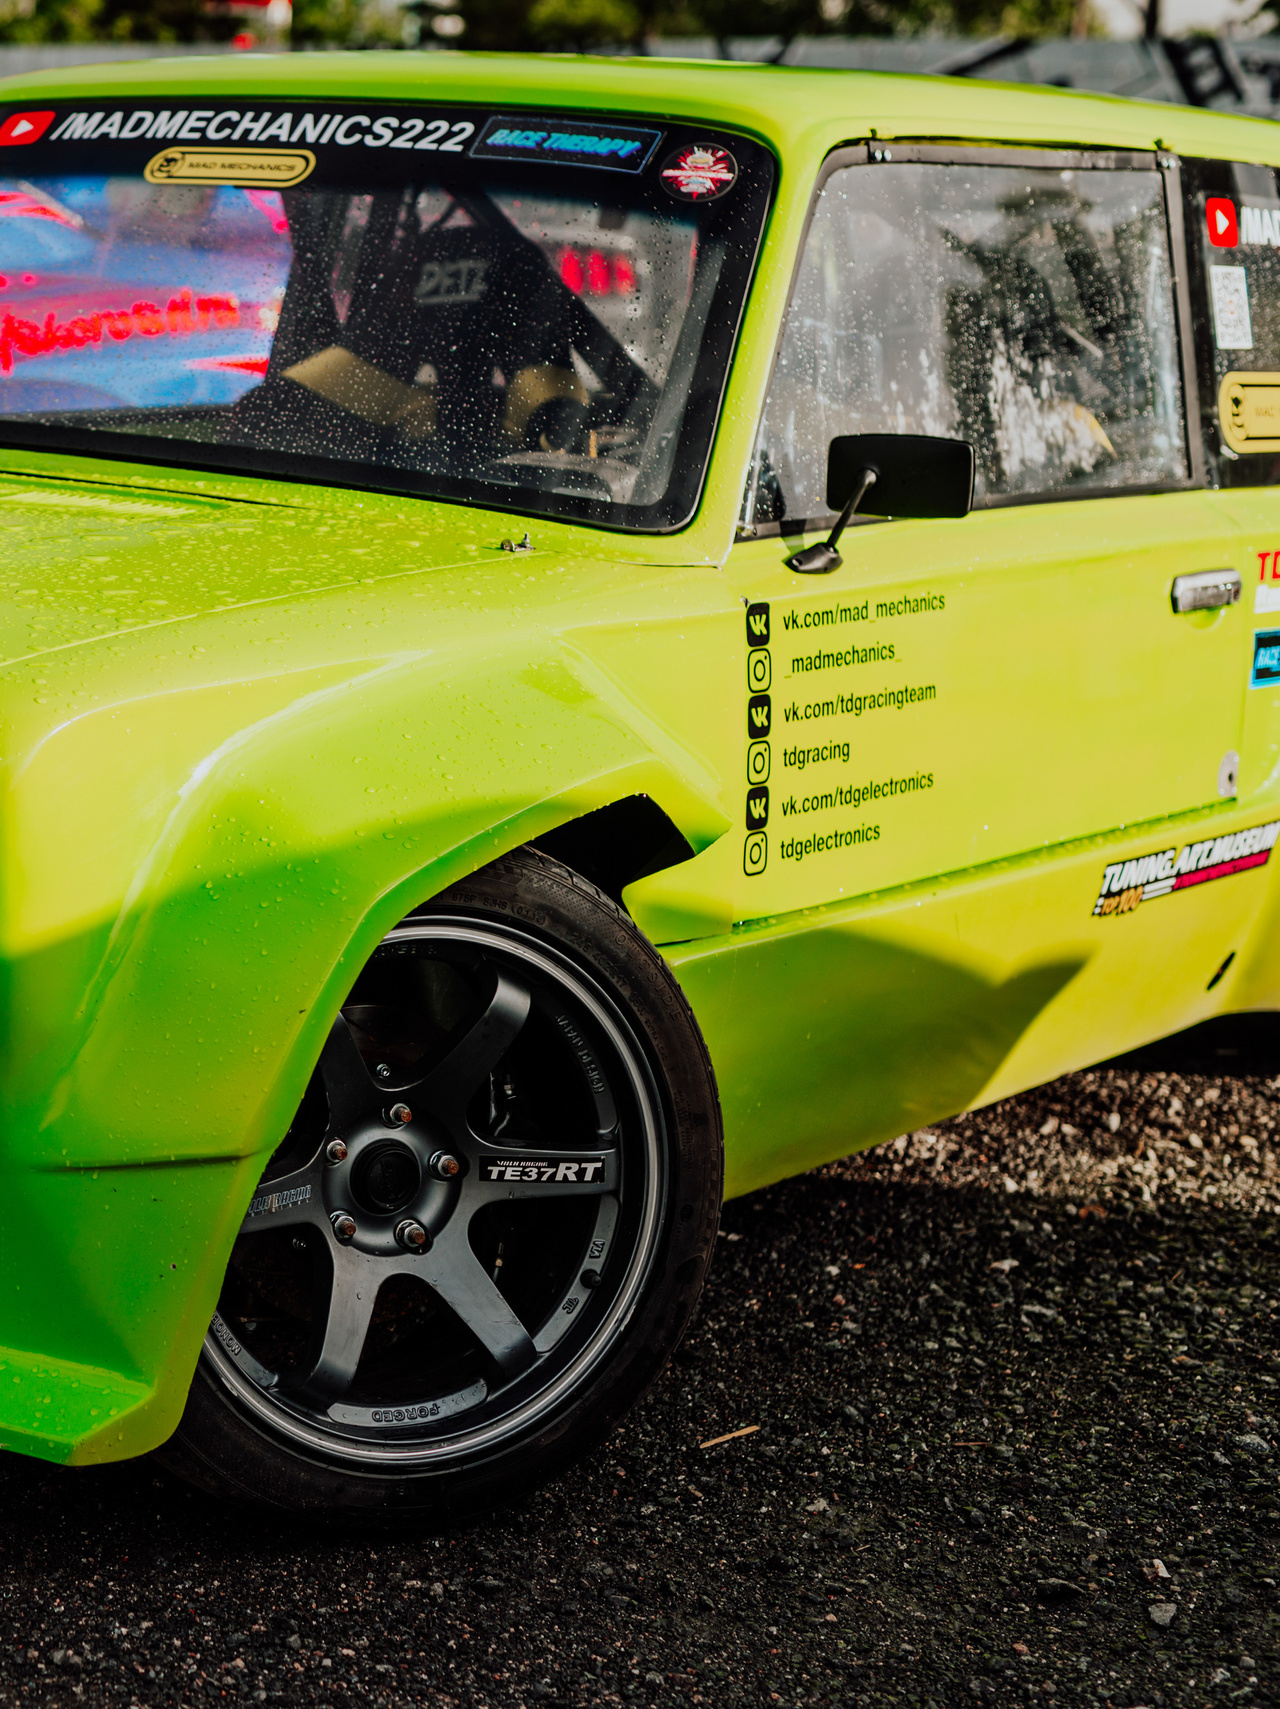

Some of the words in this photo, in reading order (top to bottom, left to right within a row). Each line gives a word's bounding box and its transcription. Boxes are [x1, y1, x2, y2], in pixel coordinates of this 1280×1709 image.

[49, 110, 475, 152] /MADMECHANICS222
[783, 592, 945, 630] vk.com/mad_mechanics
[784, 684, 936, 723] vk.com/tdgracingteam
[783, 740, 850, 770] tdgracing
[782, 771, 934, 816] vk.com/tdgelectronics
[780, 823, 881, 861] tdgelectronics
[615, 934, 682, 1021] OUTSIDE
[487, 1162, 603, 1181] TE37RT
[371, 1402, 441, 1423] FORGED
